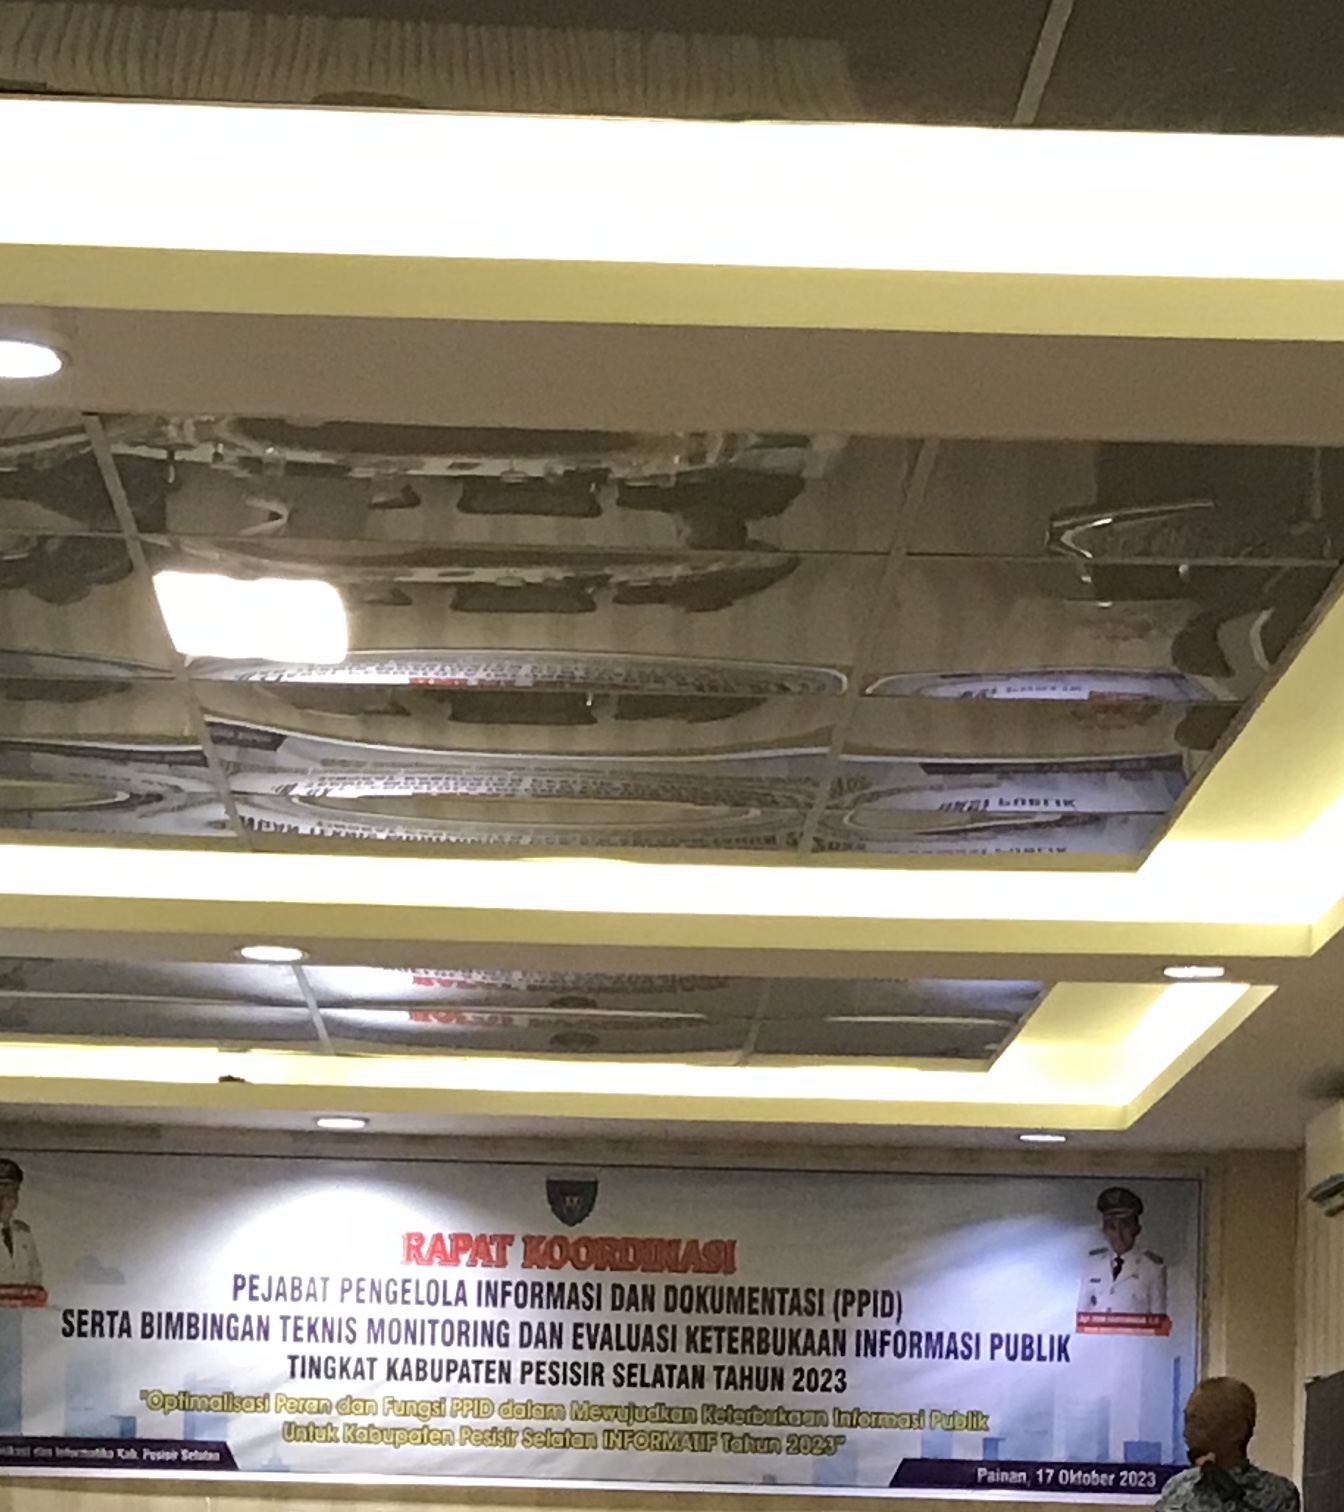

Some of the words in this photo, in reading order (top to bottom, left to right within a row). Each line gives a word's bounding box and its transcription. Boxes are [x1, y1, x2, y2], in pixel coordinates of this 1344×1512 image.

[402, 1231, 515, 1268] RAPAT
[521, 1234, 737, 1274] KOORDINASI
[232, 1274, 330, 1303] PEJABAT
[341, 1277, 466, 1308] PENGELOLA
[477, 1280, 602, 1312] INFORMASI
[611, 1284, 655, 1313] DAN
[664, 1285, 824, 1317] DOKUMENTASI
[833, 1289, 903, 1324] (PPID)
[61, 1308, 132, 1340] SERTA
[141, 1311, 270, 1342] BIMBINGAN
[279, 1315, 357, 1344] TEKNIS
[367, 1317, 510, 1349] MONITORING
[518, 1321, 564, 1351] DAN
[572, 1322, 677, 1354] EVALUASI
[686, 1325, 847, 1358] KETERBUKAAN
[855, 1329, 981, 1361] INFORMASI
[989, 1332, 1071, 1363] PUBLIK
[287, 1354, 378, 1383] TINGKAT
[386, 1357, 512, 1386] KABUPATEN
[520, 1360, 605, 1389] PESISIR
[612, 1363, 706, 1391] SELATAN
[713, 1365, 784, 1393] TAHUN
[792, 1367, 848, 1395] 2023
[140, 1390, 271, 1415] "Optimalisasi
[274, 1392, 333, 1415] Peran
[336, 1394, 377, 1416] dan
[382, 1396, 447, 1420] Fungsi
[450, 1397, 494, 1419] PPID
[498, 1398, 567, 1421] dalam
[570, 1403, 698, 1426] Mewujudkan
[701, 1405, 829, 1428] Keterbukaan
[833, 1408, 925, 1430] Informasi
[930, 1410, 990, 1432] Publik
[282, 1422, 338, 1444] Untuk
[344, 1424, 455, 1447] Kabupaten
[458, 1427, 518, 1447] Pesisir
[522, 1428, 597, 1450] Selatan
[602, 1432, 718, 1453] INFORMATIF
[721, 1434, 781, 1454] Tahun
[785, 1436, 846, 1456] 2023"
[976, 1467, 1031, 1487] Painan,
[1036, 1469, 1055, 1485] 17
[1058, 1469, 1115, 1487] Oktober
[1119, 1470, 1157, 1488] 2023
